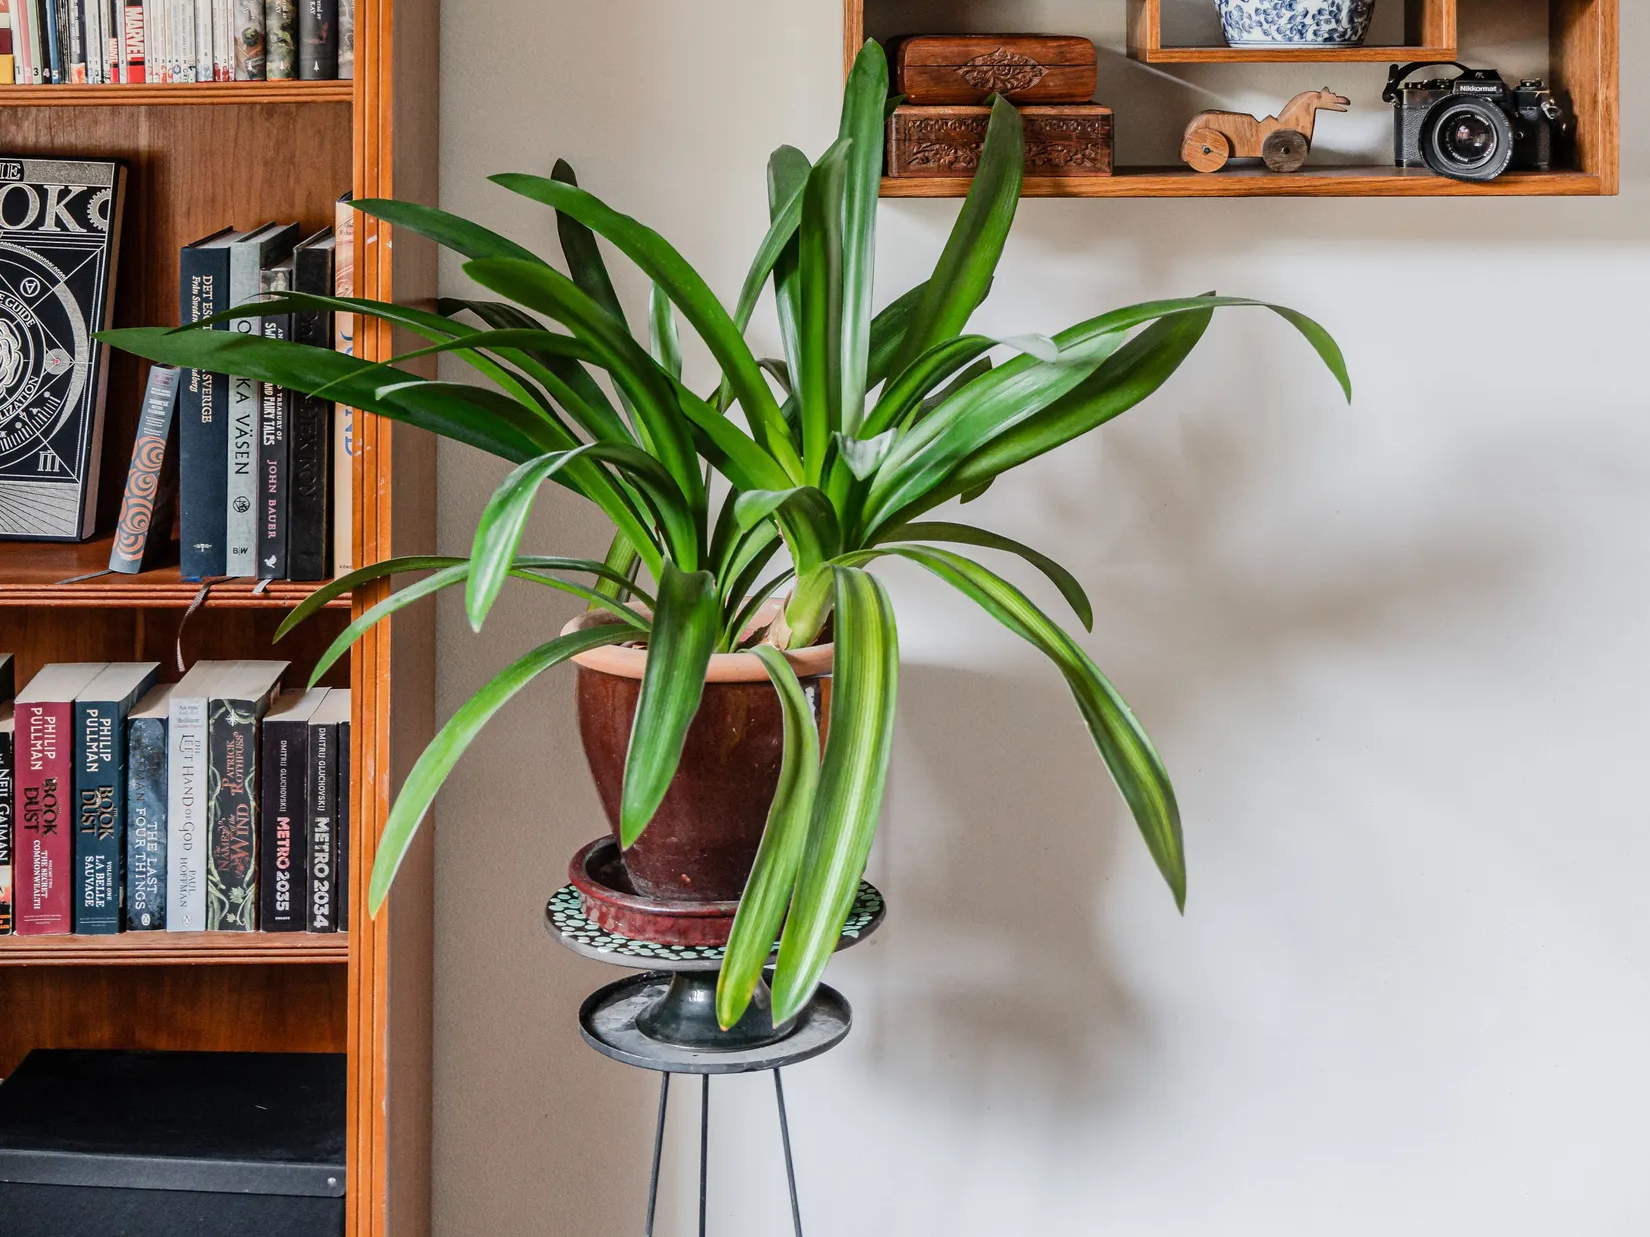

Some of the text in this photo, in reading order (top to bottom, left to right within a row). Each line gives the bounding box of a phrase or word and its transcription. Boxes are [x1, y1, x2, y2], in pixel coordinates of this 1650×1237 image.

[108, 38, 117, 64] MARVEL
[126, 8, 144, 61] MARVEL
[33, 68, 39, 76] 3
[43, 68, 50, 78] 4
[52, 70, 59, 79] 5
[192, 276, 200, 294] Från
[202, 275, 213, 299] DET
[5, 297, 36, 327] GUIDE
[202, 374, 212, 423] SVERIGE
[263, 397, 275, 419] FAIRY
[235, 414, 253, 475] VÄSEN
[263, 422, 275, 445] TALES
[277, 432, 282, 440] OF
[267, 460, 277, 538] JOHN BAUER
[31, 708, 43, 770] PULLMAN
[44, 717, 55, 759] PHILIP
[87, 709, 98, 772] PULLMAN
[100, 718, 111, 762] PHILIP
[179, 734, 194, 761] LEFT
[318, 728, 326, 758] DMITRIJ
[182, 765, 194, 807] HAND
[221, 740, 234, 790] PATRICK
[229, 732, 244, 795] ROTHFUSS
[24, 787, 39, 832] DUST
[42, 778, 57, 837] BOOK
[80, 790, 98, 835] DUST
[97, 786, 115, 840] BOOK
[185, 809, 192, 820] OF
[0, 804, 9, 860] GAIMAN
[178, 822, 194, 851] GOD
[218, 826, 230, 870] NAME
[231, 803, 249, 858] WIND
[276, 817, 290, 869] METRO
[135, 808, 146, 910] FOUR THINGS
[147, 822, 157, 894] THE LAST
[314, 817, 329, 927] METRO 2034
[85, 856, 94, 907] SAUVAGE
[96, 855, 104, 907] LA BELLE
[276, 871, 290, 911] 2035
